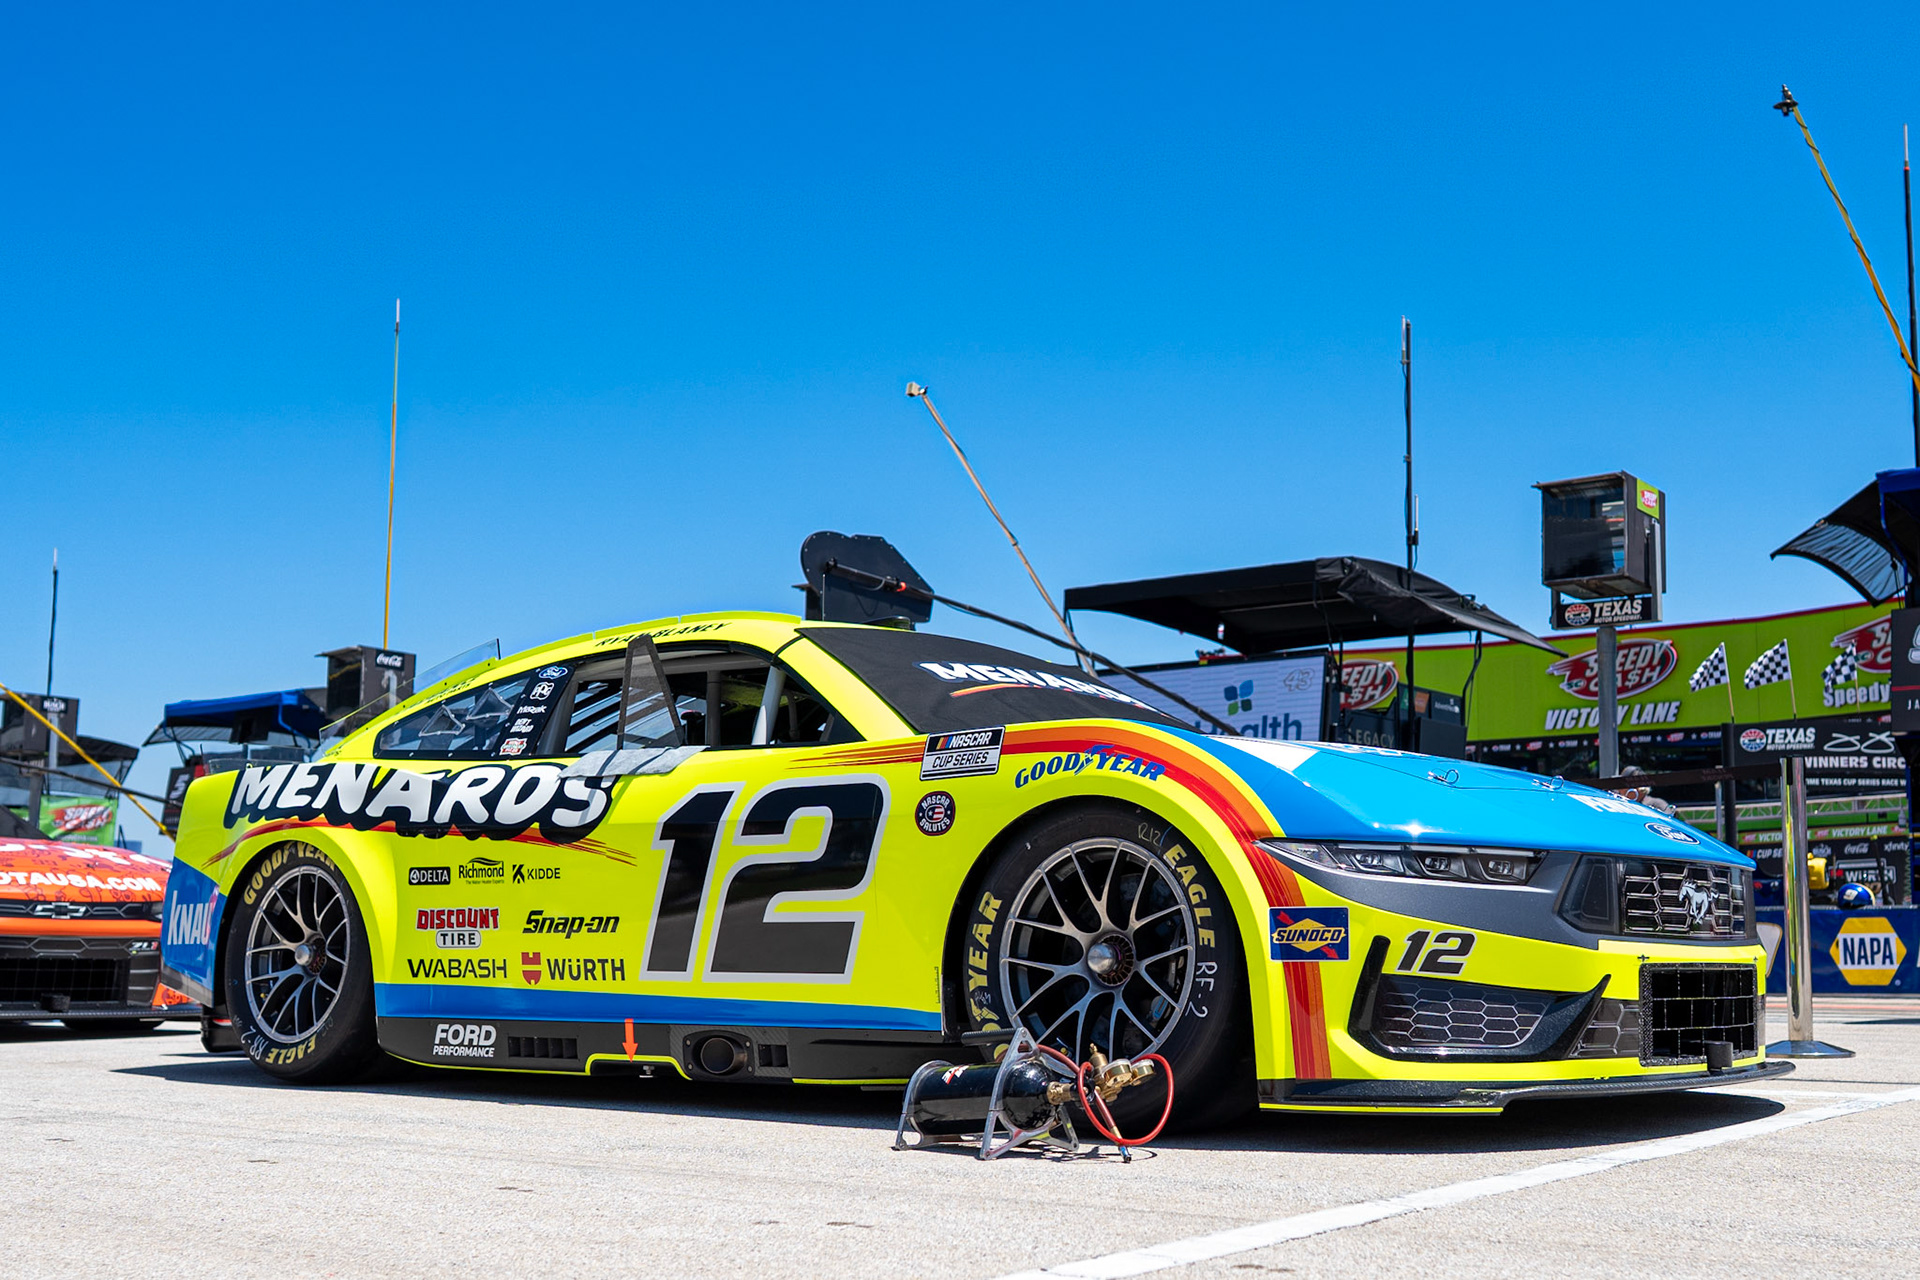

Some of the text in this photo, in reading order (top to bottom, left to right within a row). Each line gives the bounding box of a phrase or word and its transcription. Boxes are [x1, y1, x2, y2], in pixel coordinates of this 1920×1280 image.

[1593, 599, 1643, 617] TEXAS
[1283, 667, 1316, 692] 43
[1544, 700, 1681, 731] VICTOY LANE
[949, 732, 993, 749] NASCAR
[1766, 727, 1816, 744] TEXAS
[932, 752, 989, 768] CUP SERIES
[1821, 778, 1842, 786] TEXAS
[1843, 778, 1857, 786] CUP
[1858, 778, 1880, 786] SERIES
[1881, 778, 1898, 786] RACE
[230, 762, 613, 828] MENARDS
[921, 795, 950, 810] NASCAR
[919, 817, 951, 832] SALUTES
[1832, 827, 1866, 838] VICTORY
[1866, 825, 1888, 836] LANE
[1756, 848, 1771, 859] CUP
[1884, 841, 1910, 852] xfinity
[420, 869, 449, 882] DELTA
[458, 861, 504, 879] Richmond
[527, 868, 561, 880] KIDDE
[639, 772, 892, 984] 12
[1165, 843, 1216, 948] EAGLE
[416, 907, 500, 930] DISCOUNT
[522, 910, 620, 939] Snap-on
[440, 932, 476, 946] TIRE
[1275, 929, 1343, 942] SUNOCO
[129, 941, 159, 951] ZL1
[1395, 929, 1477, 976] 12
[1842, 937, 1894, 966] NAPA
[407, 958, 508, 979] WABASH
[546, 958, 626, 981] WÜRTH
[434, 1023, 497, 1046] FORD
[265, 1036, 317, 1065] EAGLE
[433, 1045, 495, 1058] PERFORMANCE
